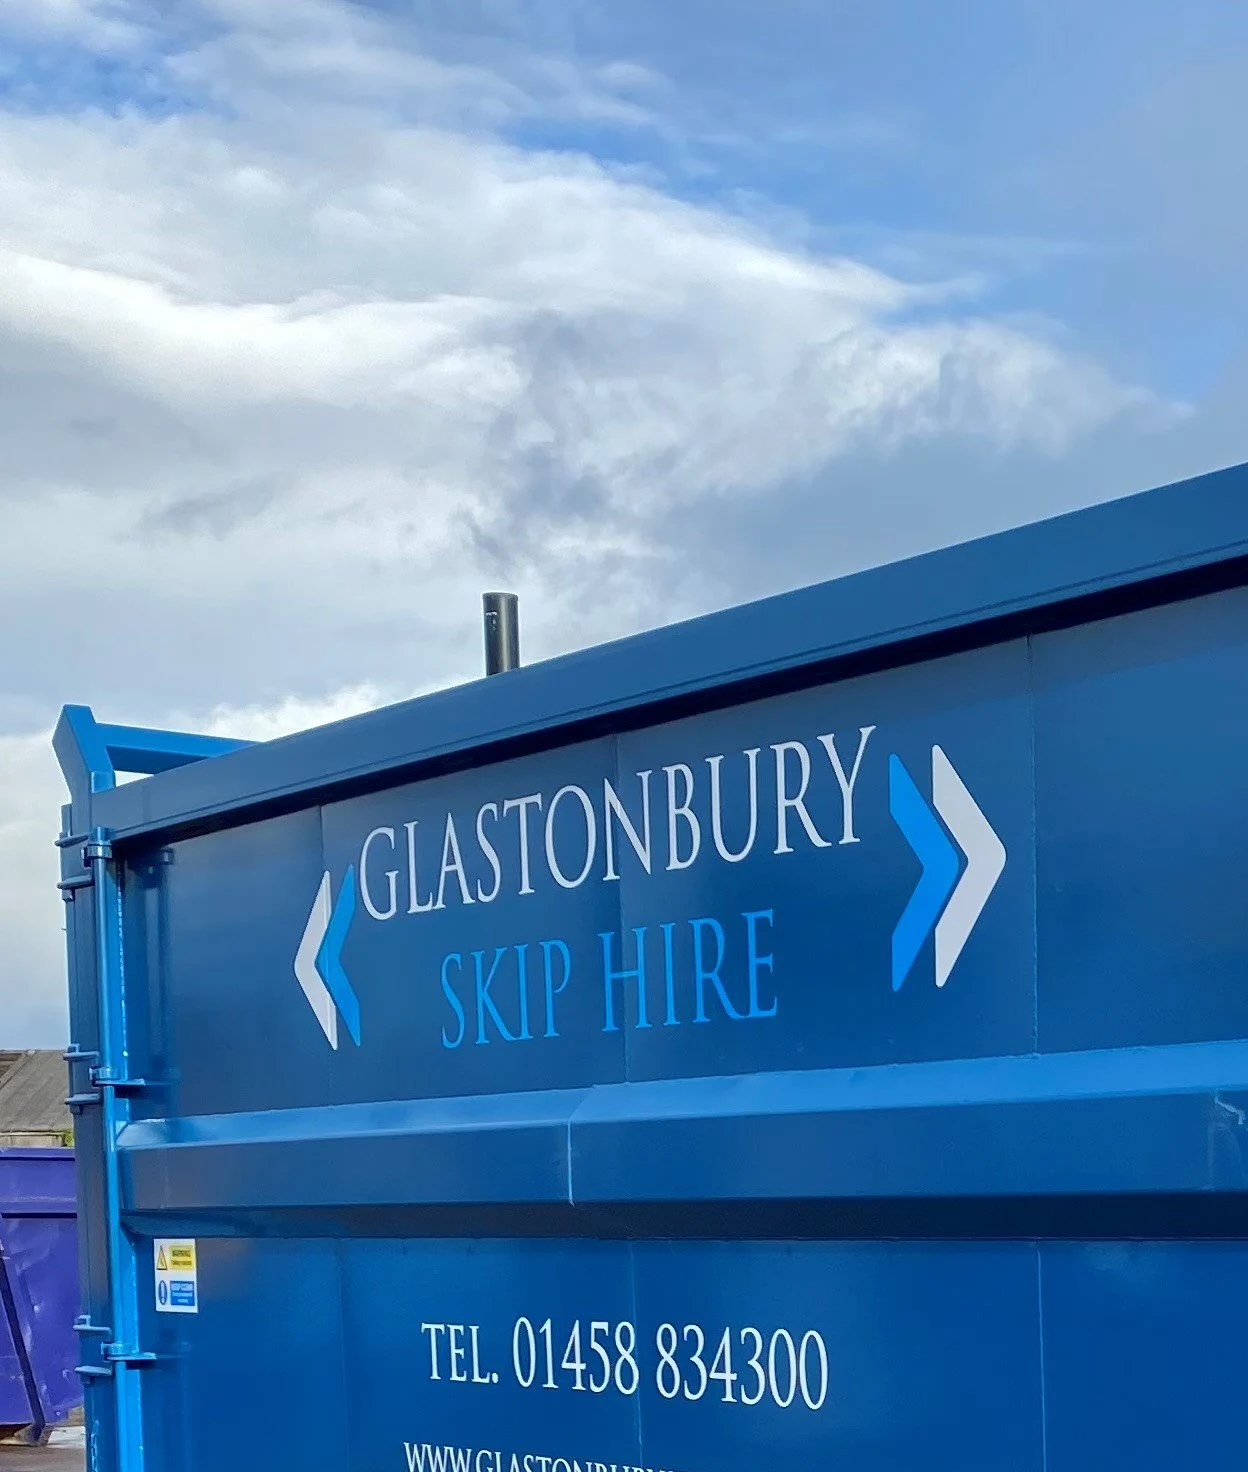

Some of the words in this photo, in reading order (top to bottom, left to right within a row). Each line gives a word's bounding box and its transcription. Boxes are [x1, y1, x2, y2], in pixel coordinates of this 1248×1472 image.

[359, 725, 876, 921] GLASTONBURY
[440, 939, 571, 1049] SKIP
[597, 908, 779, 1032] HIRE
[421, 1321, 499, 1385] TEL.
[512, 1316, 640, 1396] 01458
[655, 1322, 830, 1411] 834300
